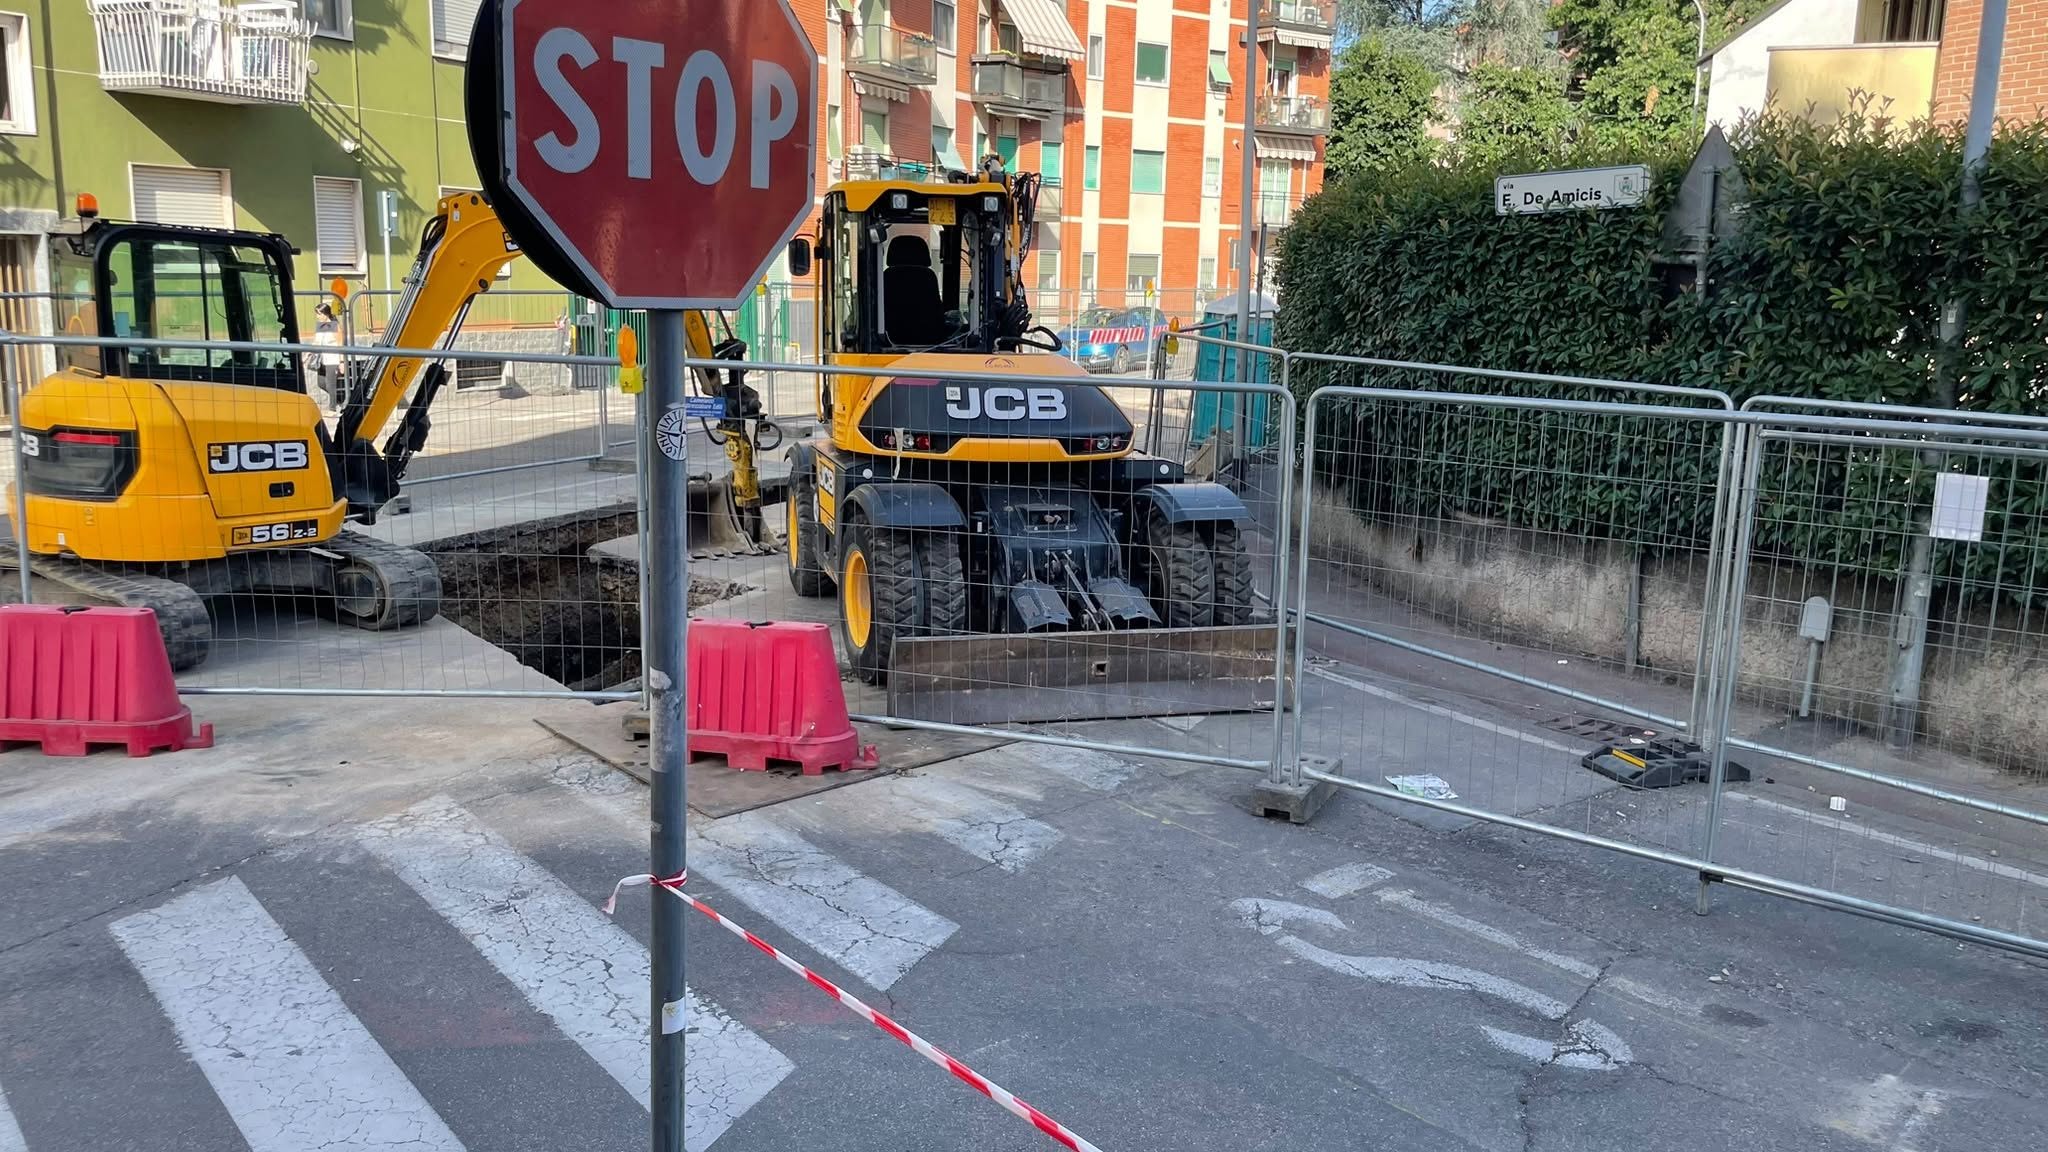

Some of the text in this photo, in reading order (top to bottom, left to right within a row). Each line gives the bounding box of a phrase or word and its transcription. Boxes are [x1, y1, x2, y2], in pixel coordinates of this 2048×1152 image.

[533, 27, 799, 189] STOP
[1502, 187, 1602, 207] E. De Amicis
[1503, 182, 1514, 190] via
[946, 387, 1067, 420] JCB
[210, 442, 308, 472] JCB
[251, 523, 290, 543] 56
